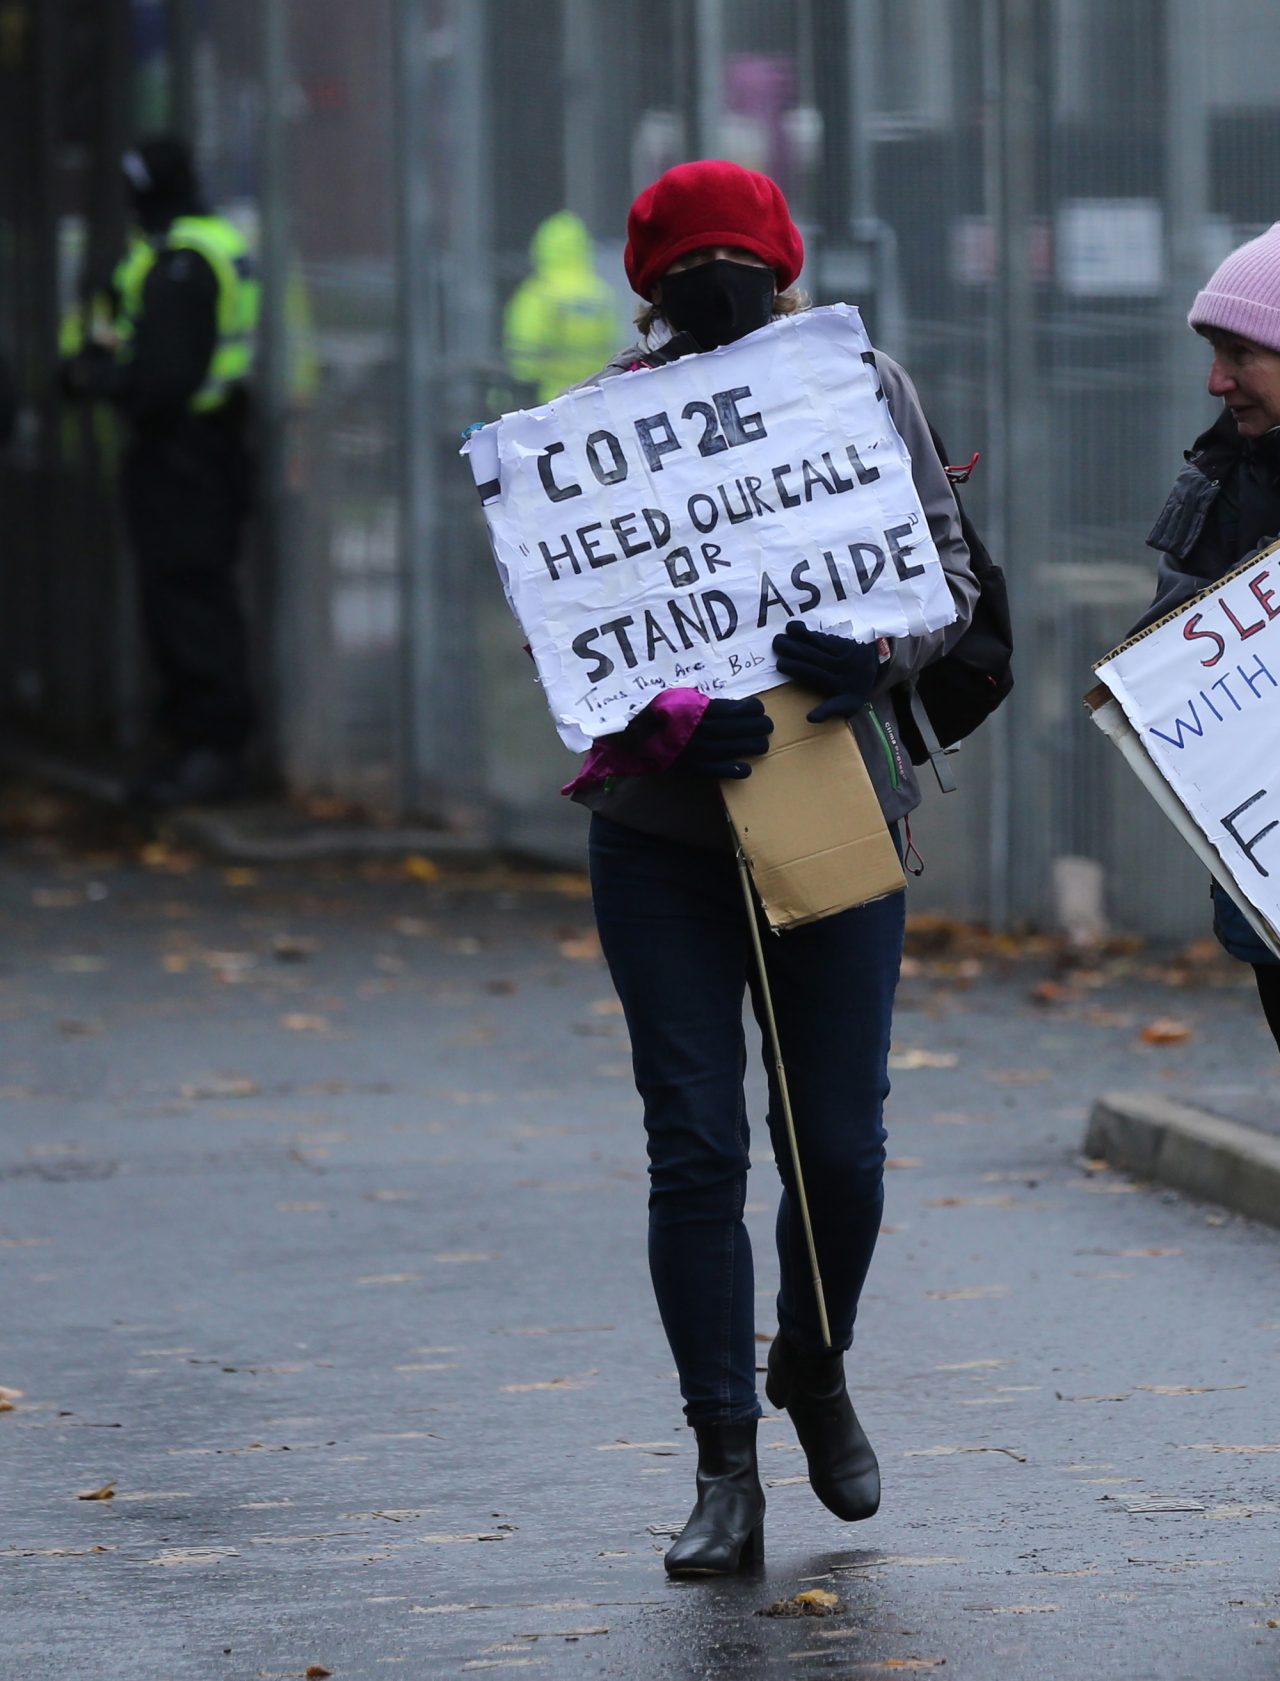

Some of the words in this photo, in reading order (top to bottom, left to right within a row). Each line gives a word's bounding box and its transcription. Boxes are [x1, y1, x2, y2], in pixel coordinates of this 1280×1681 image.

[688, 476, 775, 534] OUR
[664, 543, 731, 588] OR
[571, 590, 738, 684] STAND
[675, 663, 705, 678] Are
[728, 652, 765, 677] Bob
[1149, 654, 1279, 749] WITH
